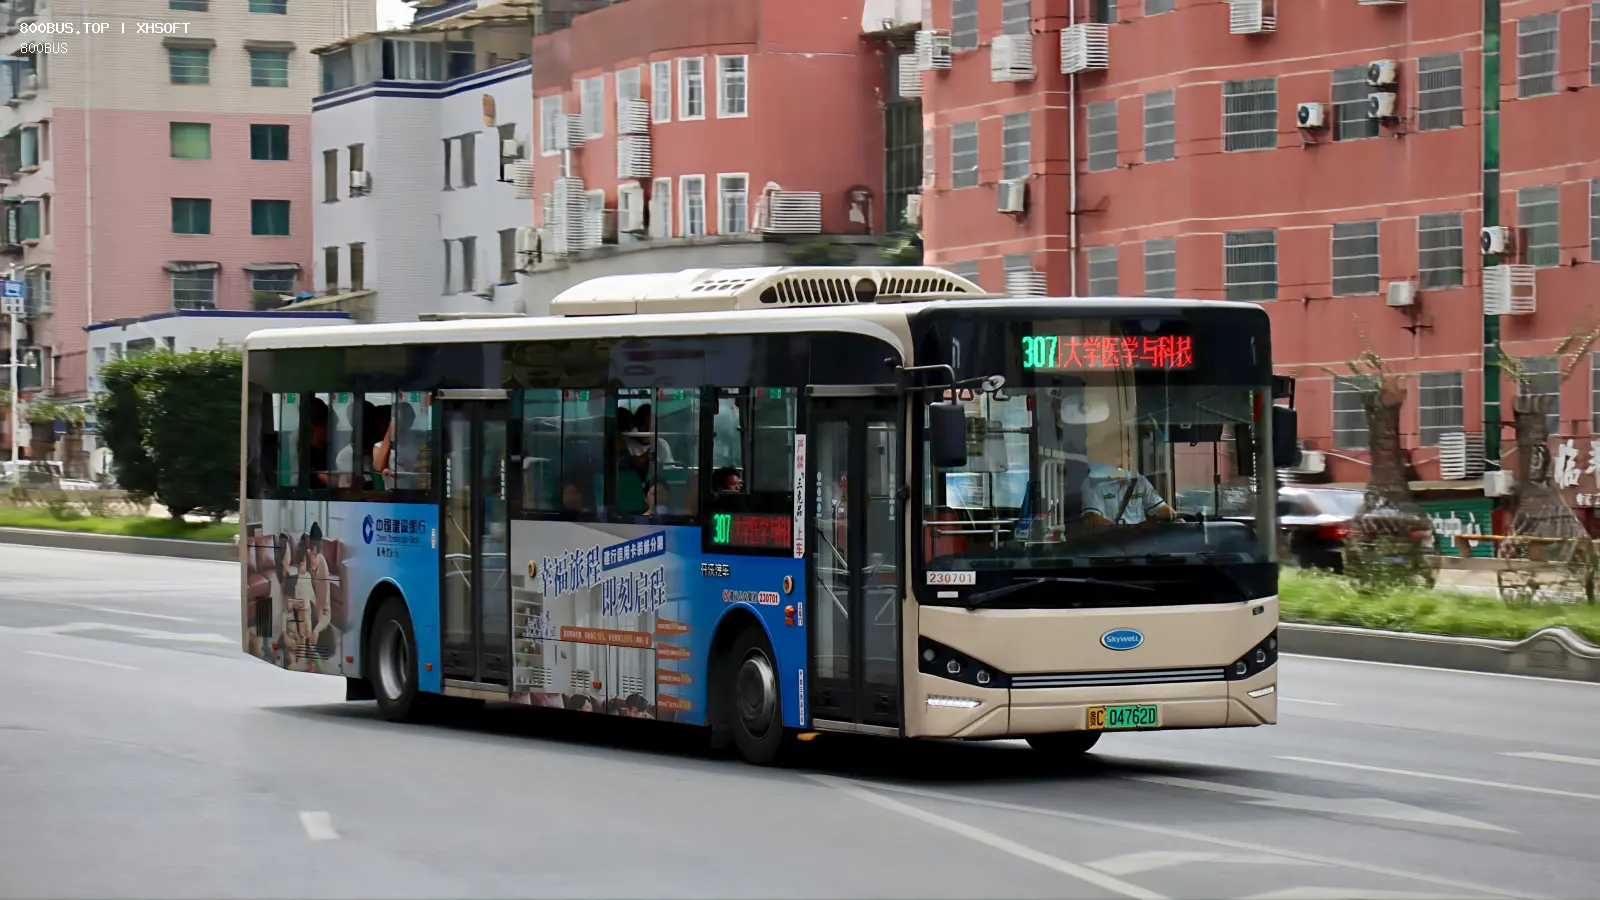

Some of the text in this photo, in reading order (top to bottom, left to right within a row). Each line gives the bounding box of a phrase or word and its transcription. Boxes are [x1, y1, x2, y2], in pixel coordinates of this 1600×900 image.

[1022, 336, 1193, 368] 307 大学医学与科技
[714, 514, 731, 543] 307
[538, 544, 601, 598] 幸福旅程
[929, 573, 972, 583] 230701
[601, 566, 666, 617] 即刻启程
[759, 592, 779, 604] 230701
